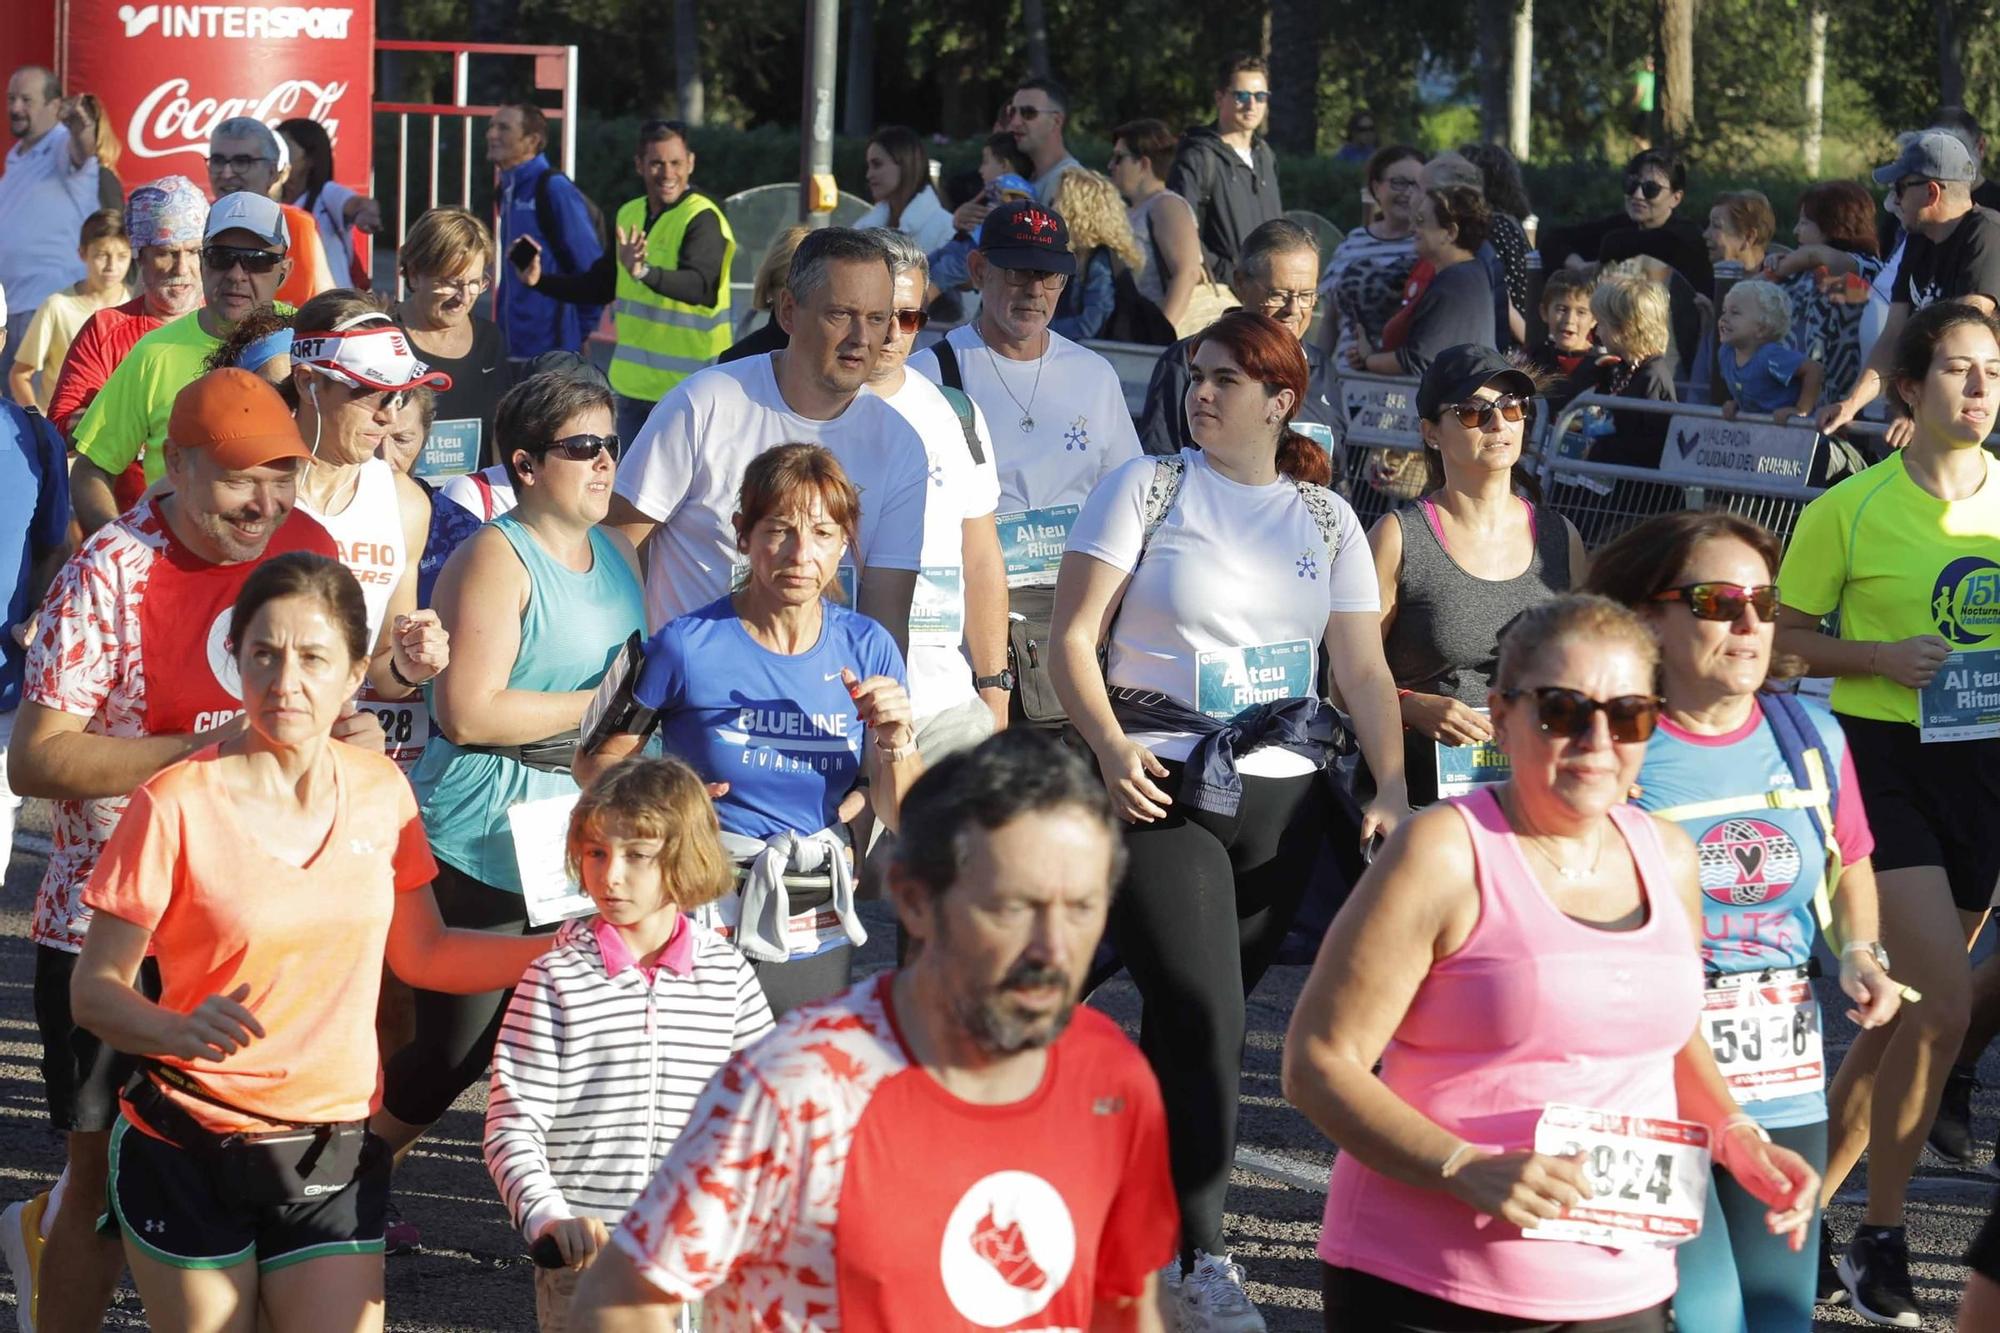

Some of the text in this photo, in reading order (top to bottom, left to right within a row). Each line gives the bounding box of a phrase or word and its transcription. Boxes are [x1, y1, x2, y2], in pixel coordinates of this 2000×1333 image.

[162, 5, 353, 39] INTERSPORT
[438, 437, 461, 449] teu
[425, 450, 464, 465] Ritme
[1696, 449, 1735, 470] CIUDAD
[1735, 453, 1756, 473] DEL
[1016, 524, 1066, 542] Al teu
[1028, 541, 1066, 558] Ritm
[1249, 666, 1286, 684] teu
[1944, 669, 1969, 690] Al
[1234, 686, 1290, 705] Ritme
[1957, 690, 2000, 709] Ritm
[360, 708, 413, 743] 28
[738, 708, 848, 738] BLUELINE
[1472, 749, 1512, 768] Ritm
